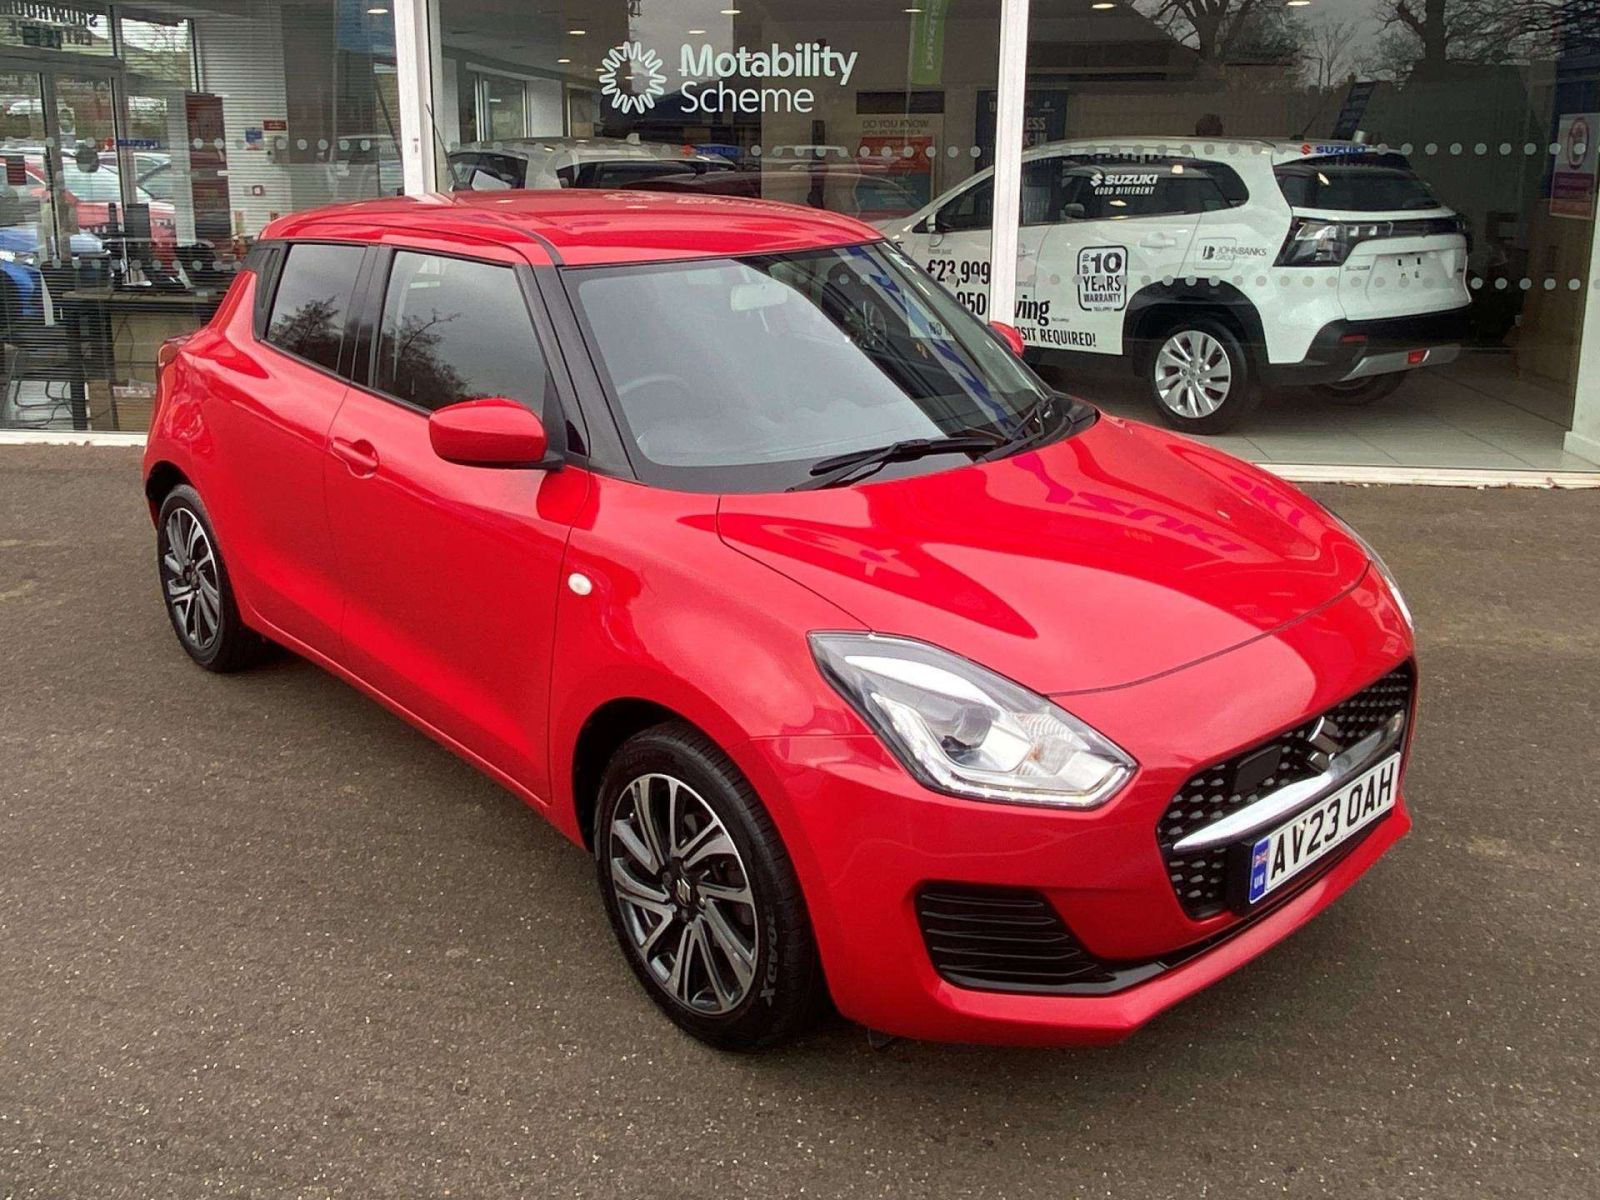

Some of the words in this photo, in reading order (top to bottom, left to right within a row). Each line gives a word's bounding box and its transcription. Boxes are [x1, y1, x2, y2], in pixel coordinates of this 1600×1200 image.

[680, 43, 858, 86] Motability
[680, 81, 815, 113] Scheme
[863, 119, 877, 128] DO
[879, 119, 897, 128] YOU
[900, 119, 929, 128] KNOW
[1315, 145, 1366, 154] SUZUKI
[1104, 174, 1159, 185] SUZUKI
[1094, 186, 1114, 195] GOOD
[1115, 186, 1155, 195] DIFFERENT
[1091, 252, 1122, 274] 10
[926, 259, 991, 288] £23,999
[1084, 293, 1121, 303] WARRANTY
[1040, 328, 1097, 347] REQUIRED!
[1270, 798, 1341, 881] AV23
[1346, 761, 1395, 828] OAH
